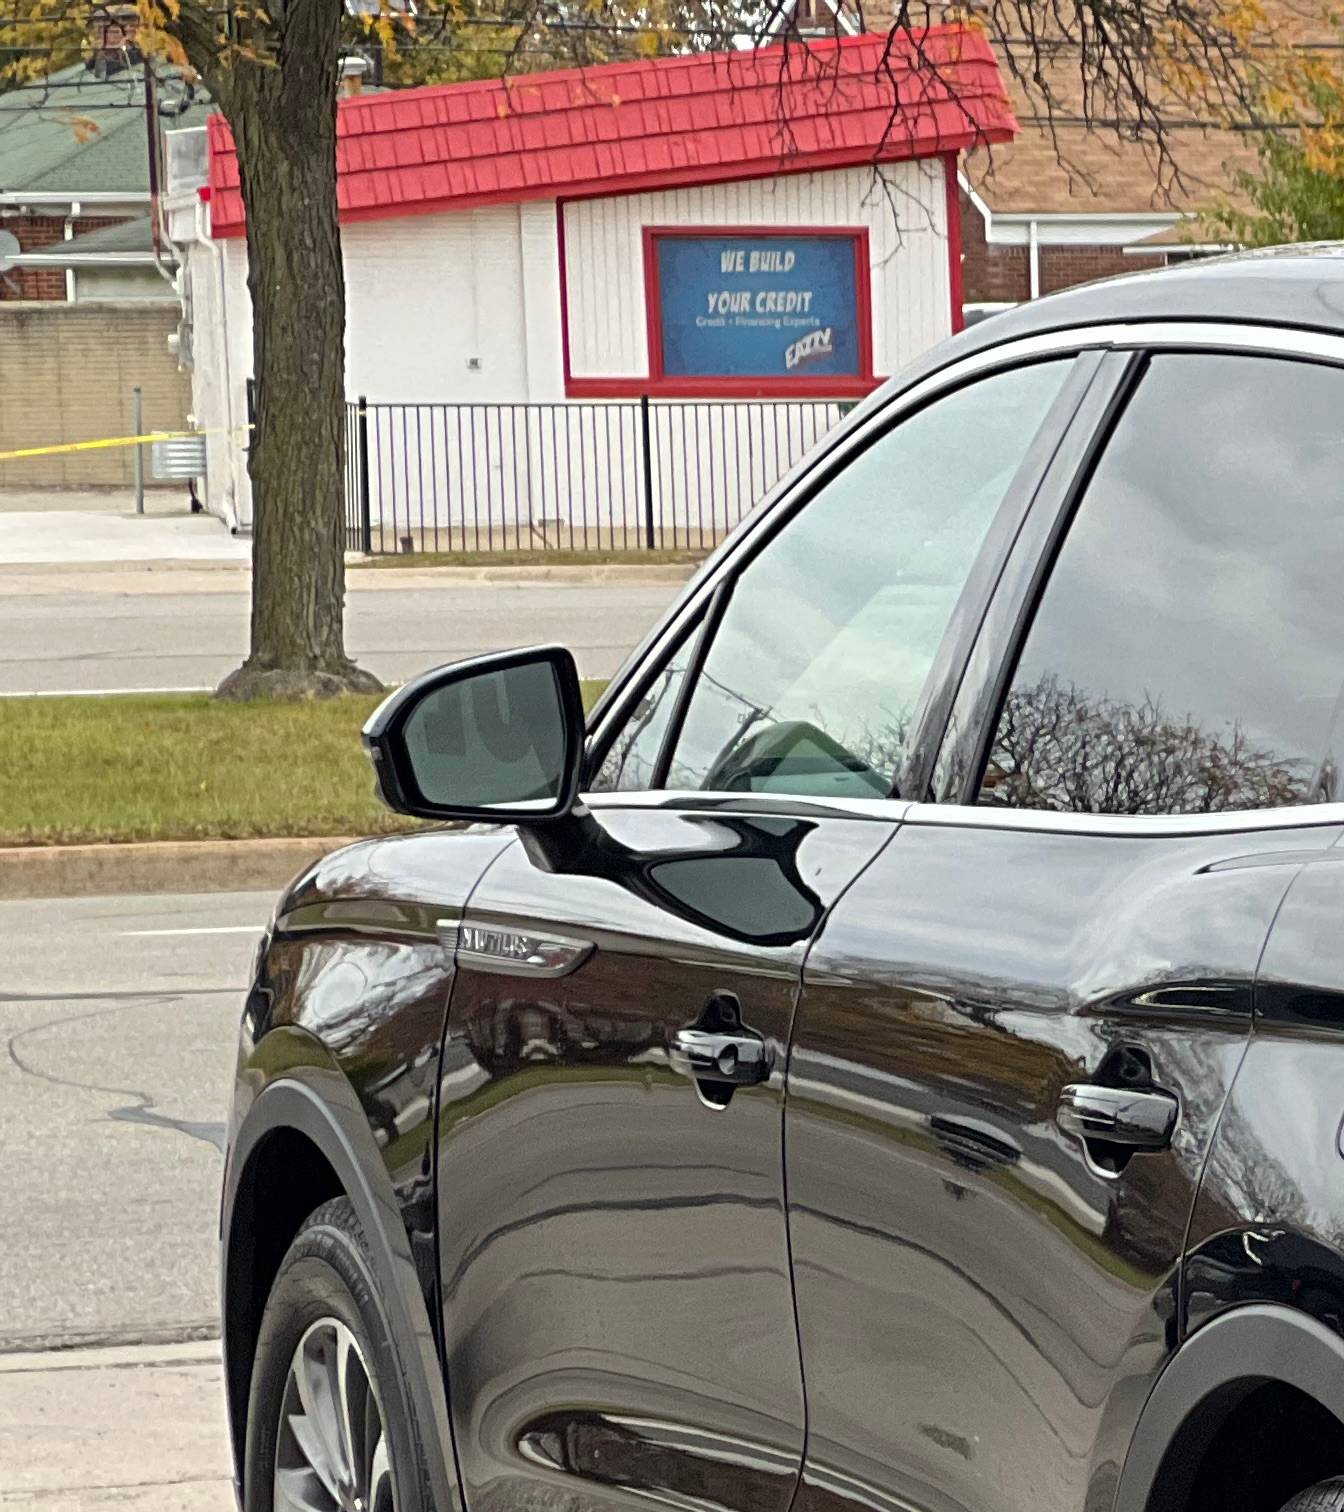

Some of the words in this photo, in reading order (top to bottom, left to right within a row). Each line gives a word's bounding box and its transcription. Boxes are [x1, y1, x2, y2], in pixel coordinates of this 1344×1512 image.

[720, 250, 744, 273] WE
[749, 250, 795, 273] BUILD
[707, 291, 750, 314] YOUR
[755, 291, 813, 314] CREDIT
